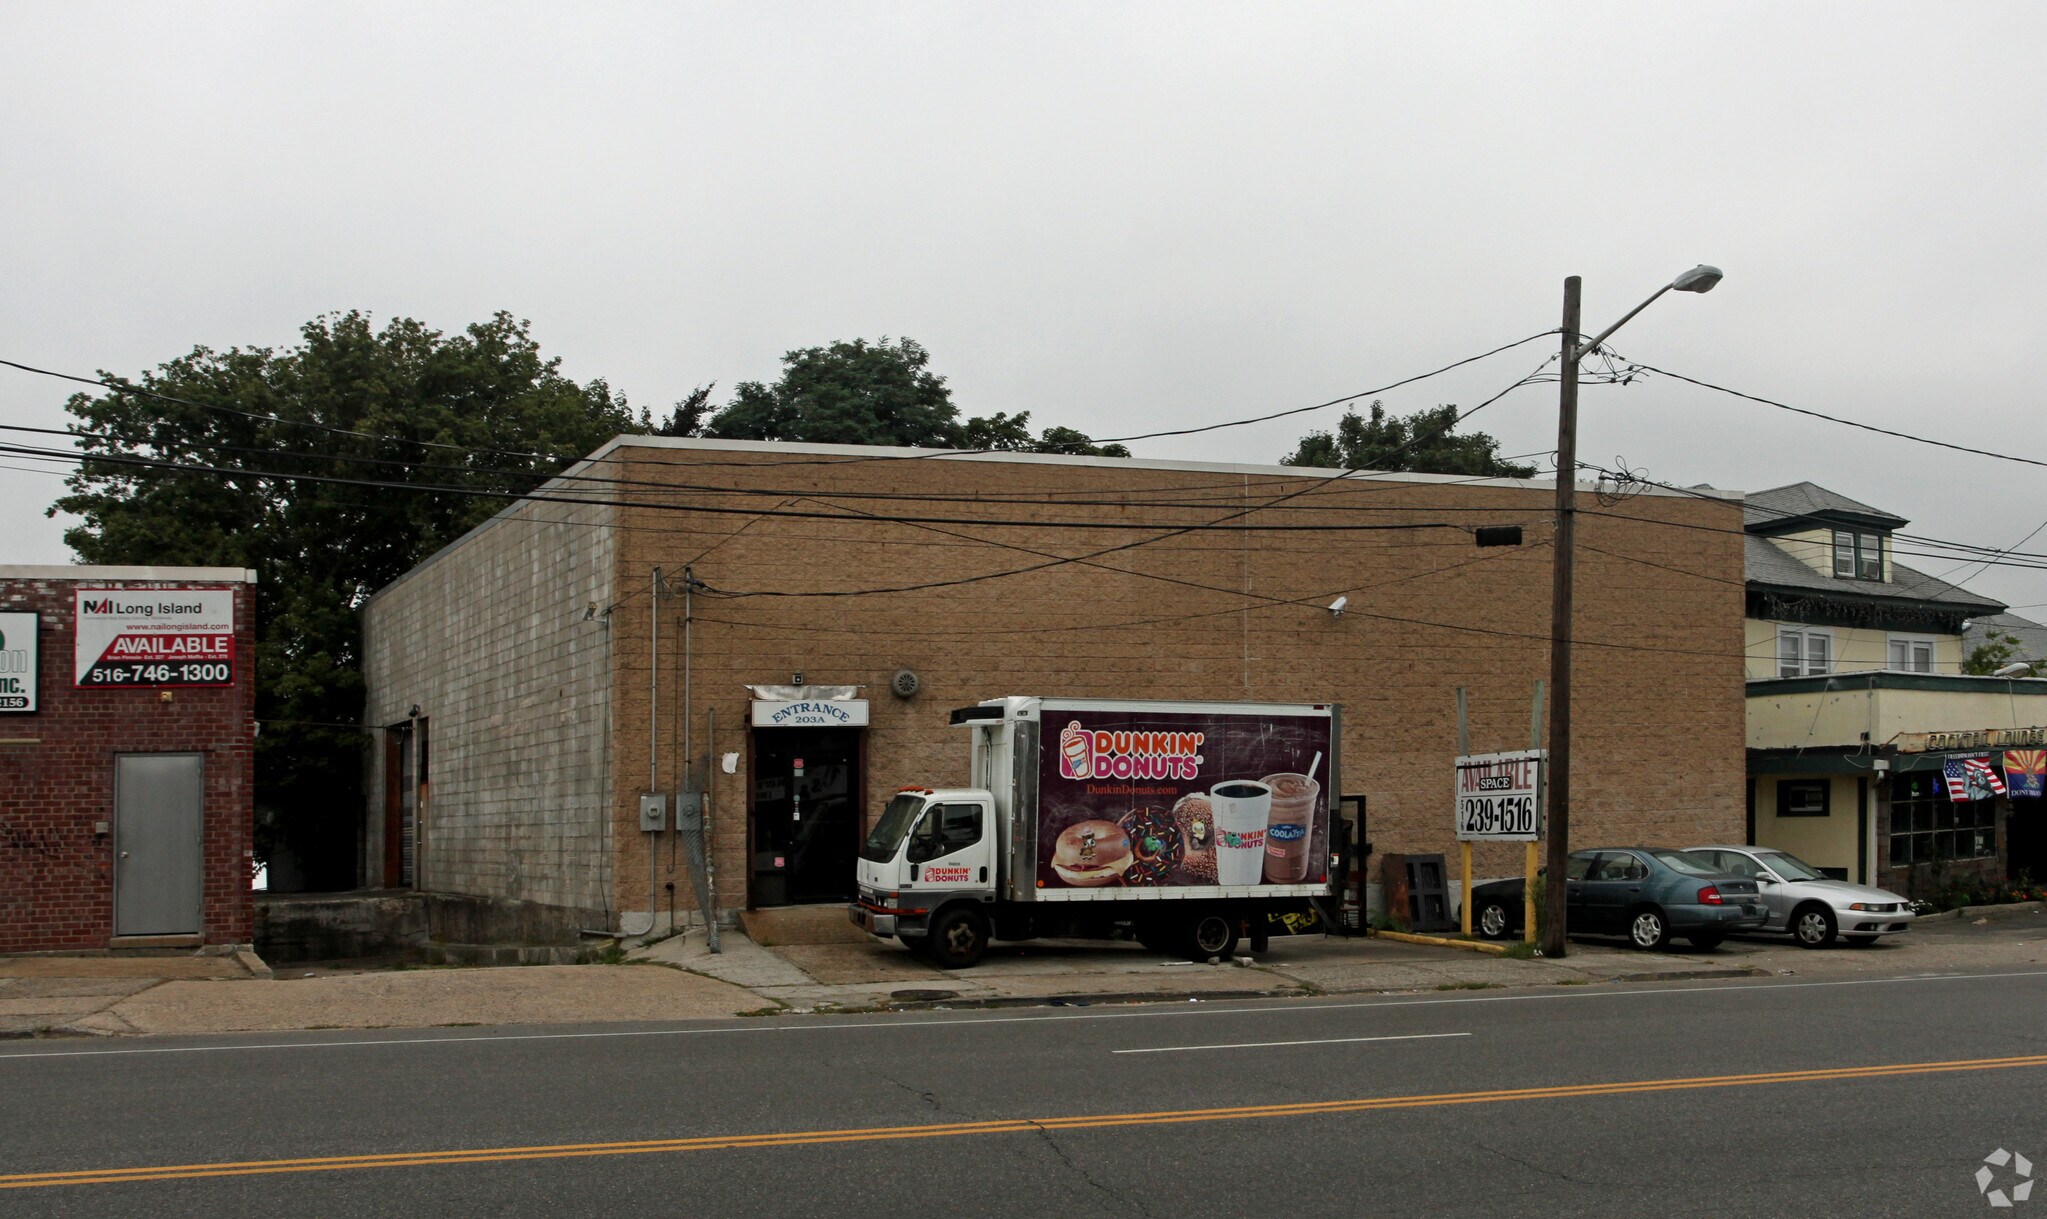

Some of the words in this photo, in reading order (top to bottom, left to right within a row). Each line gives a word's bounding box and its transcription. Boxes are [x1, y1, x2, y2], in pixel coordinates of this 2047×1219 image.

[84, 598, 113, 614] NAI
[116, 603, 153, 616] Long
[158, 603, 202, 614] Island
[126, 623, 229, 632] www.nailongisland.com
[113, 637, 228, 653] AVAILABLE
[92, 664, 228, 682] 516-746-1300
[0, 697, 24, 707] 156
[772, 703, 850, 723] ENTRANCE
[1094, 731, 1204, 755] DUNKIN'
[1094, 755, 1199, 779] DONUTS
[1087, 784, 1178, 795] DunkinDonuts.com
[1480, 778, 1510, 789] SPACE
[1466, 797, 1532, 831] 239-1516
